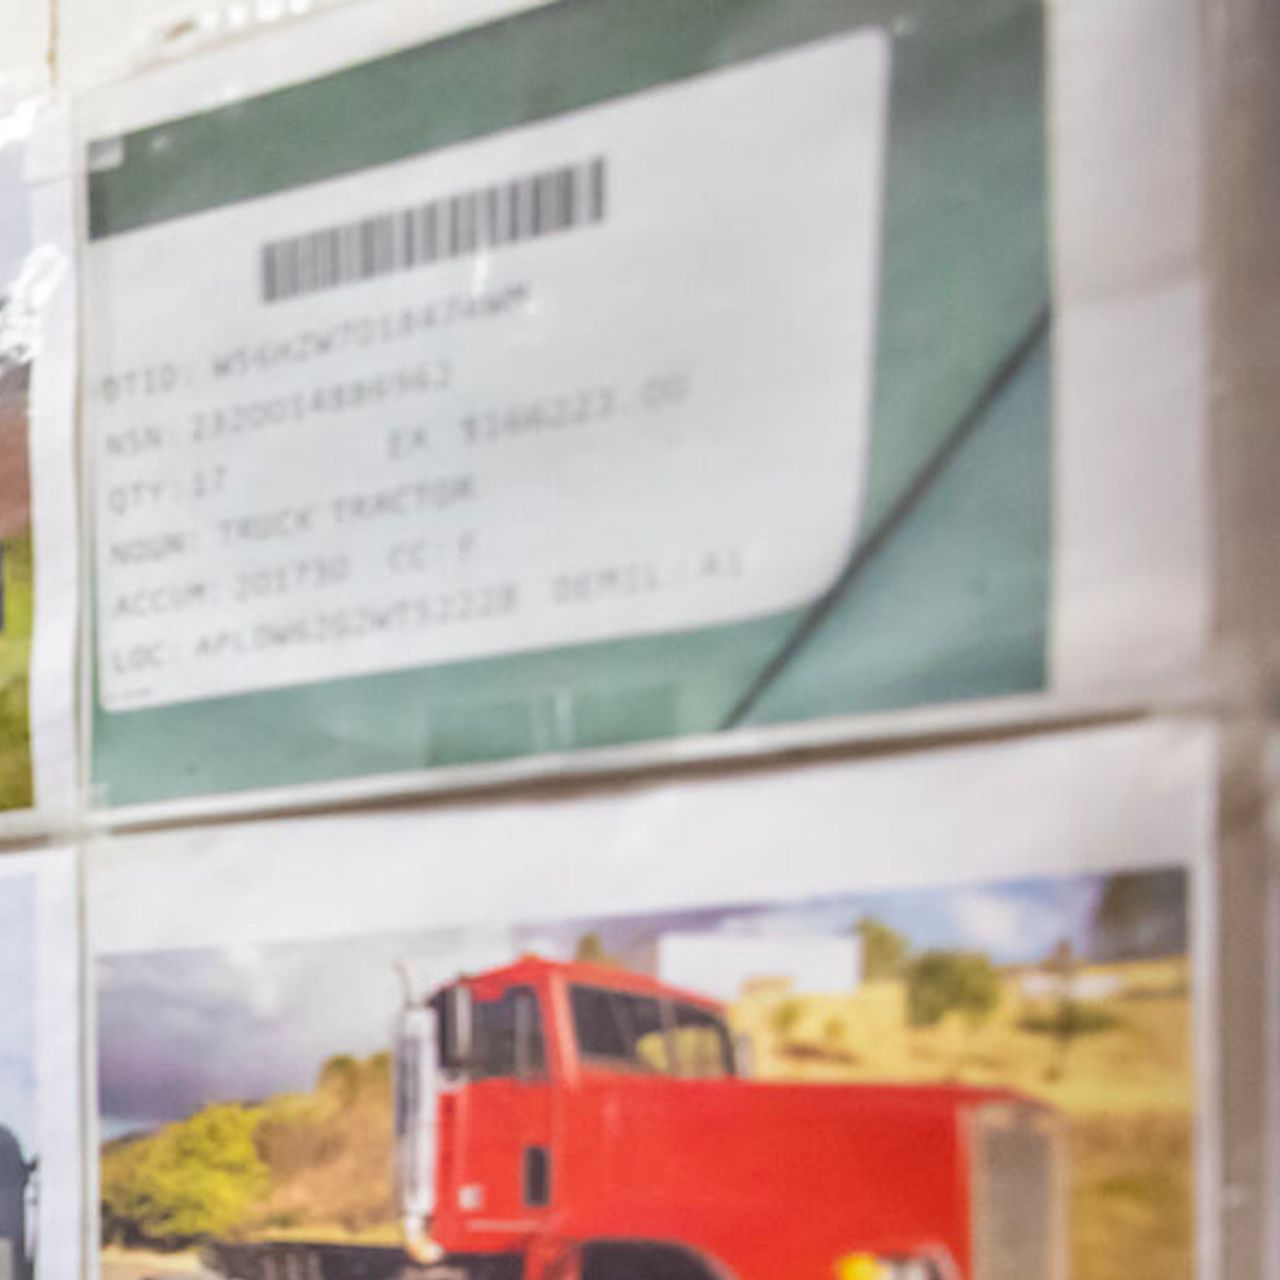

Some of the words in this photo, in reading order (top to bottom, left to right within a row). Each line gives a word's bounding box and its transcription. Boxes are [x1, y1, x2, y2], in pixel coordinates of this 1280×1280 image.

[191, 466, 227, 499] 17
[218, 505, 314, 541] TRUCK
[330, 474, 476, 525] TRACTOR
